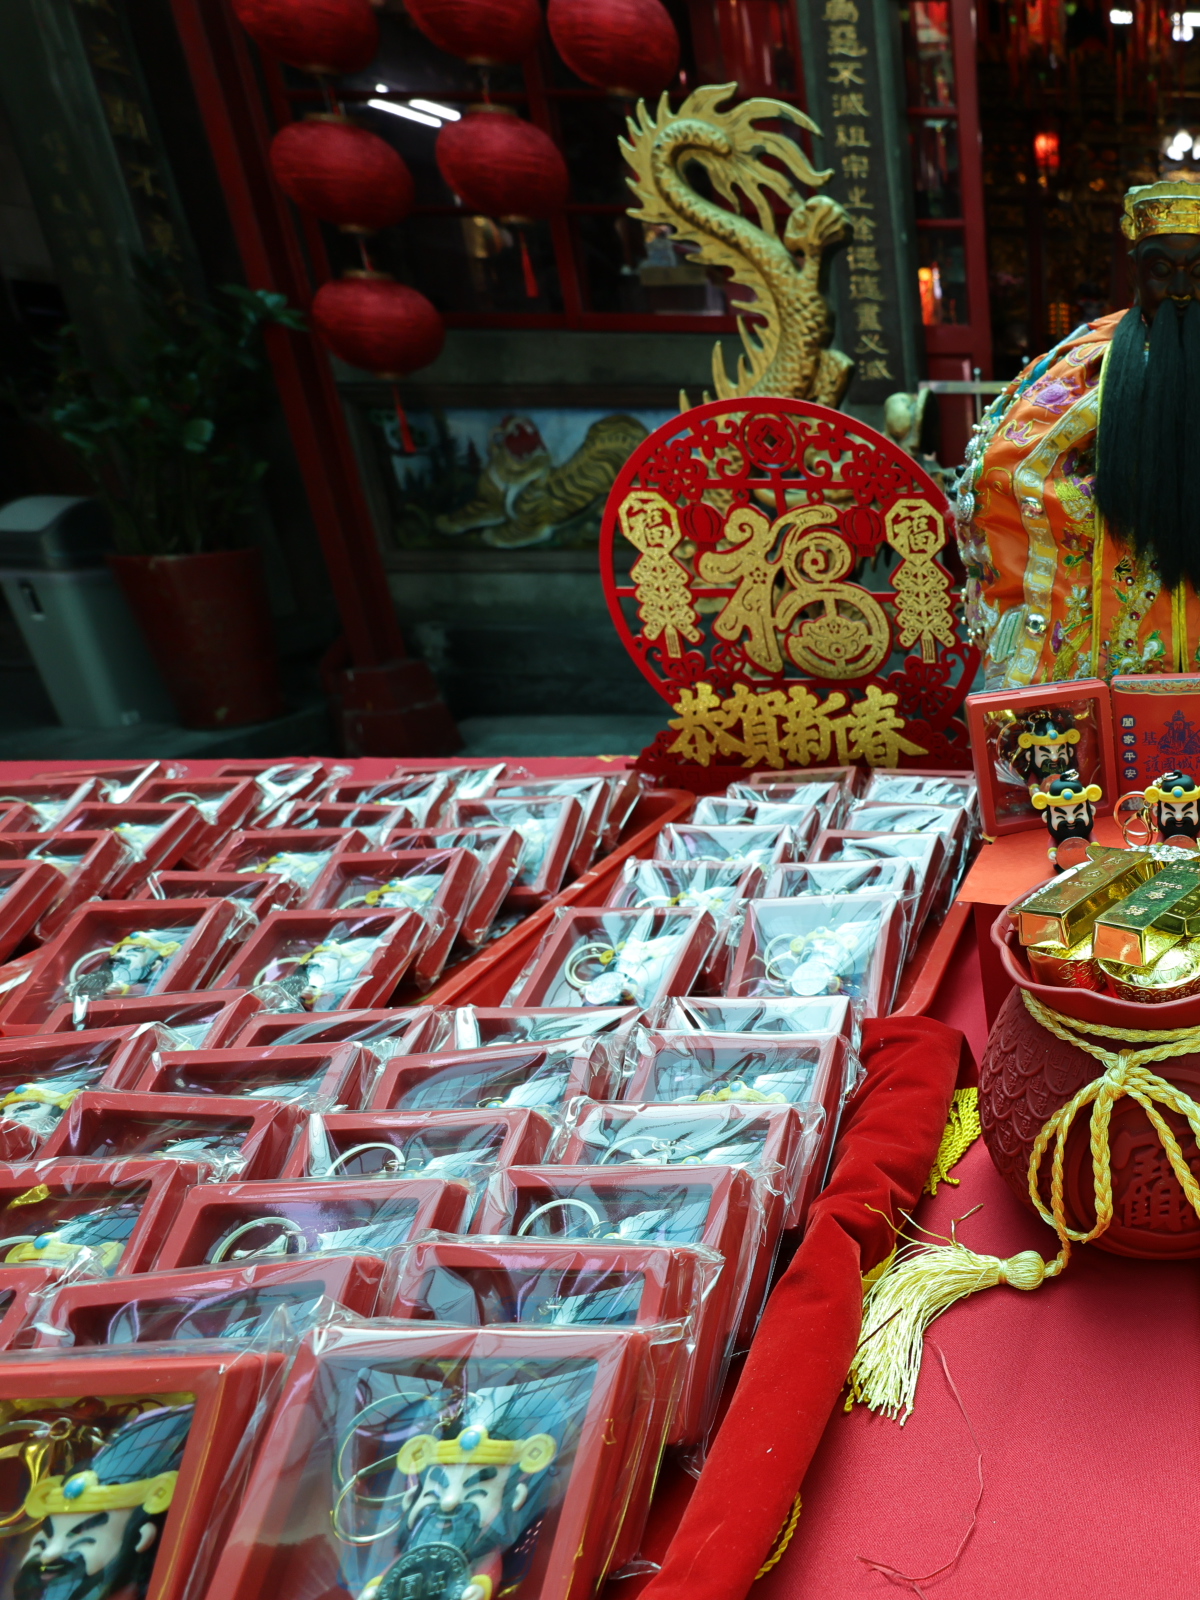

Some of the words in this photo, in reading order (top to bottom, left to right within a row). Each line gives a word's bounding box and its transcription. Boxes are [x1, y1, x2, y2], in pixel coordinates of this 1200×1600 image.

[628, 497, 675, 551] 福
[894, 505, 933, 559] 福
[697, 503, 891, 680] 福
[667, 681, 930, 770] 恭賀新春
